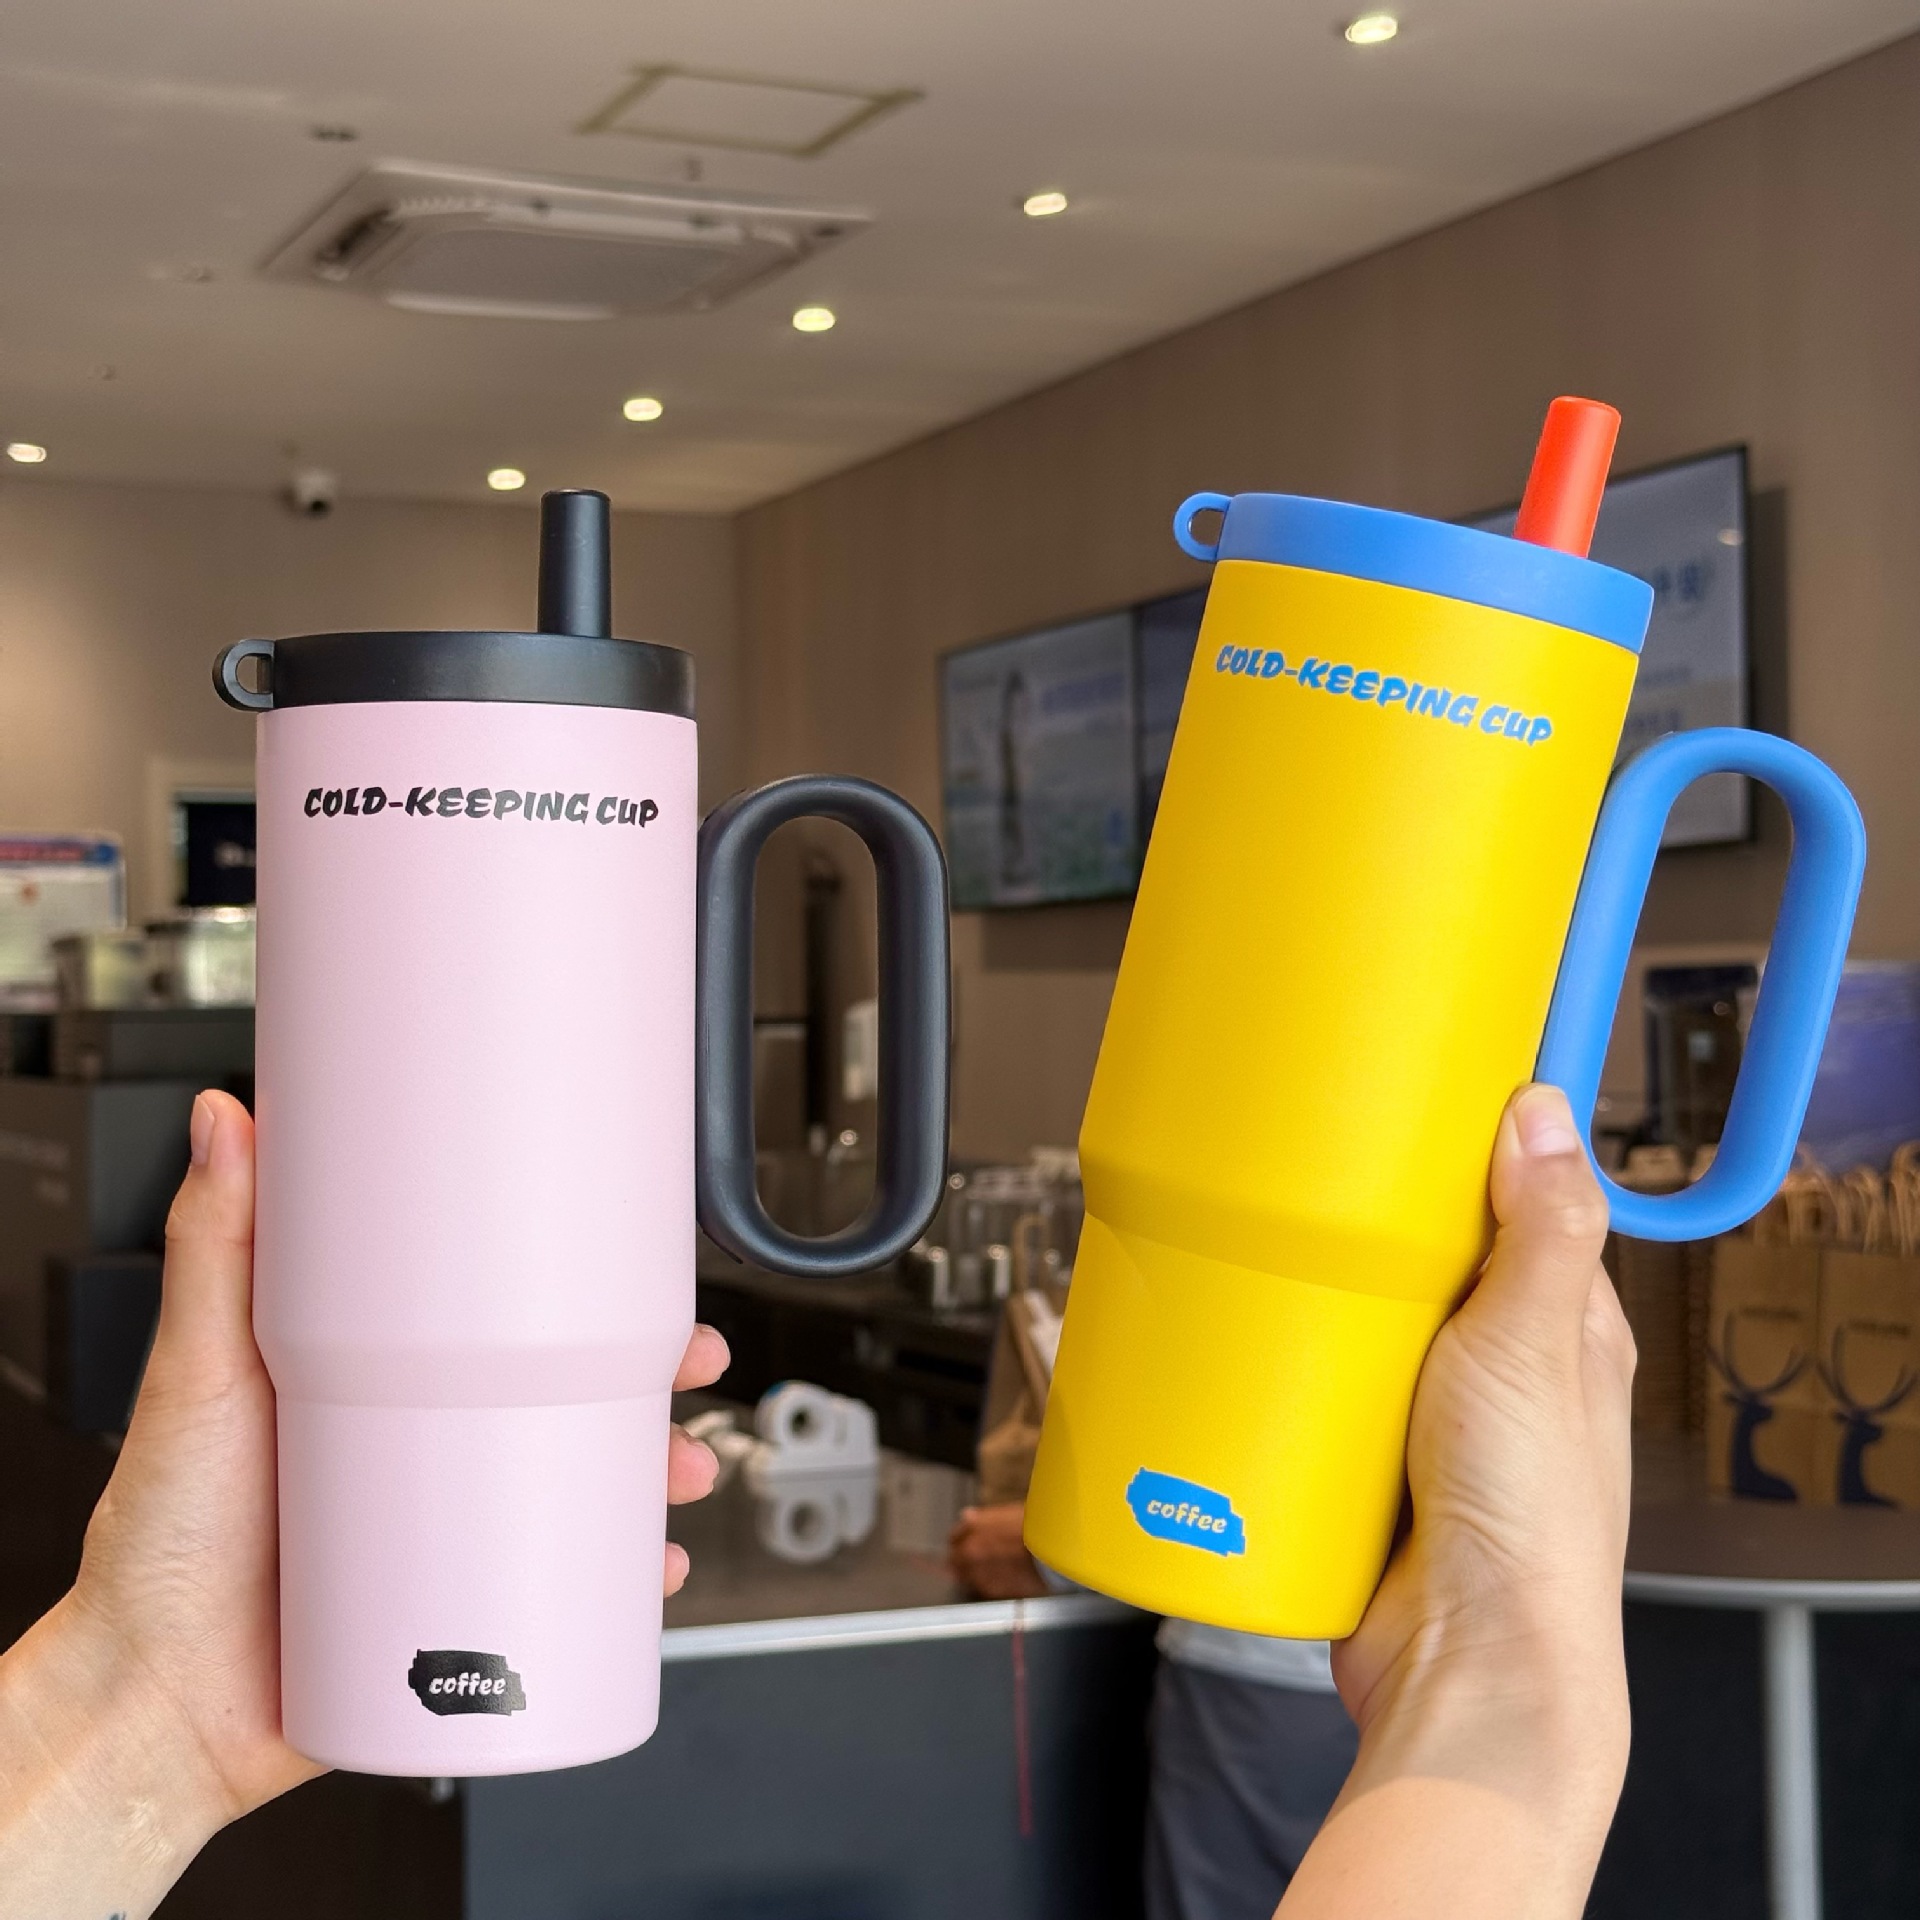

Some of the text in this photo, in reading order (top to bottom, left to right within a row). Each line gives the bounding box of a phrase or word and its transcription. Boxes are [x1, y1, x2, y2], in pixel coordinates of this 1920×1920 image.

[1215, 643, 1479, 727] COLD-KEEPING
[1480, 704, 1552, 746] CUP
[303, 786, 659, 828] COLD-KEEPING CUP
[1146, 1499, 1228, 1534] coffee
[428, 1671, 506, 1697] coffee
